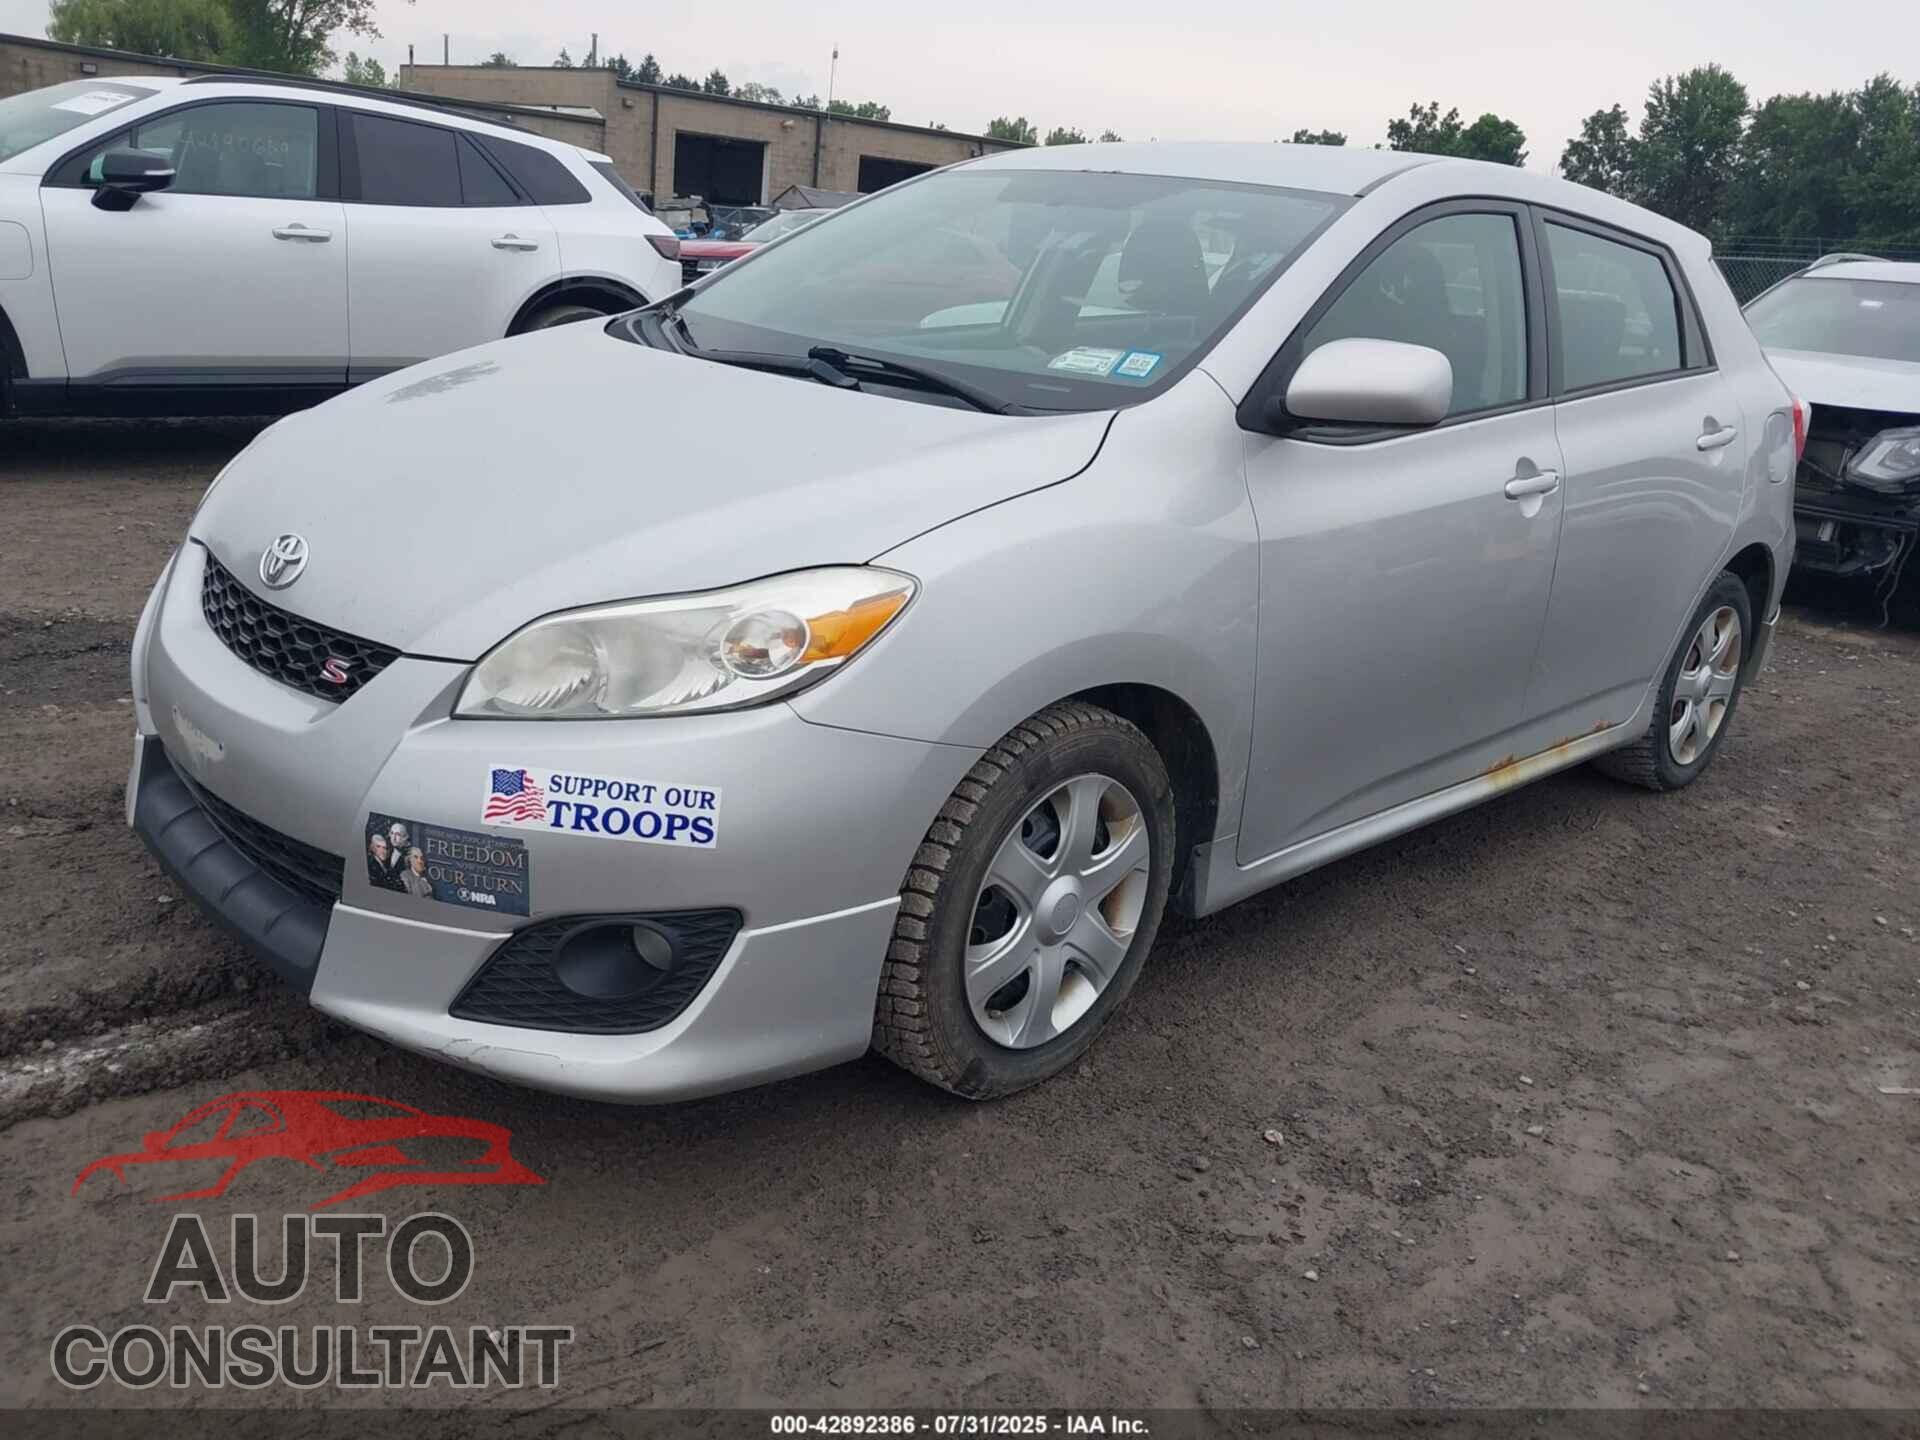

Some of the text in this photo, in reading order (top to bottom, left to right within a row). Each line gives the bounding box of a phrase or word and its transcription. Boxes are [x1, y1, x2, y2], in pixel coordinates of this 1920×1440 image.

[320, 657, 351, 684] S
[549, 774, 716, 810] SUPPORT OUR
[546, 800, 714, 844] TROOPS
[426, 837, 523, 869] FREEDOM
[428, 865, 466, 886] OUR
[470, 873, 523, 896] TURN
[471, 891, 496, 906] NRA
